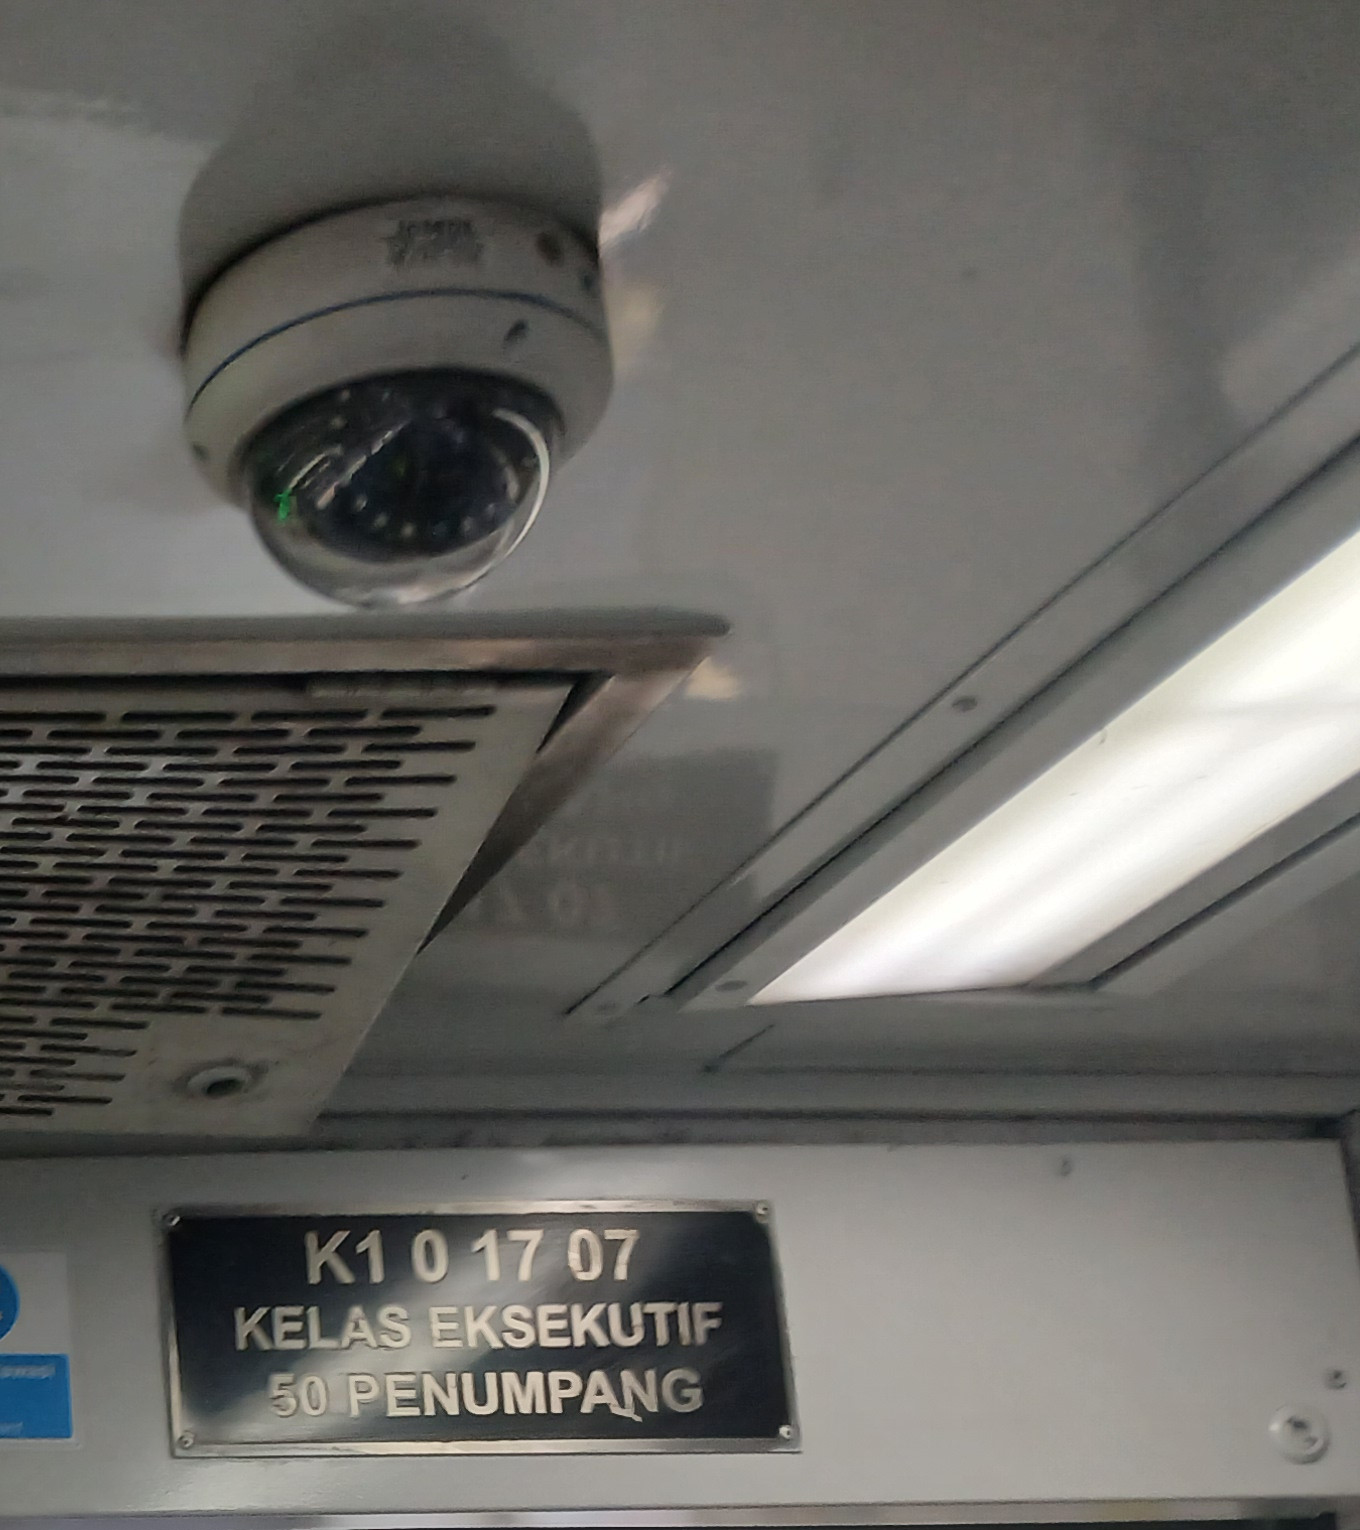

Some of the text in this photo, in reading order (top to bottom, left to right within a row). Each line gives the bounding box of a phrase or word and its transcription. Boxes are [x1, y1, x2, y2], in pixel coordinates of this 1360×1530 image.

[303, 1229, 385, 1284] K1
[471, 1228, 544, 1281] 17
[567, 1228, 640, 1281] 07
[234, 1301, 723, 1350] KELAS EKSEKUTIF
[268, 1368, 704, 1421] 50 PENUMPANG
